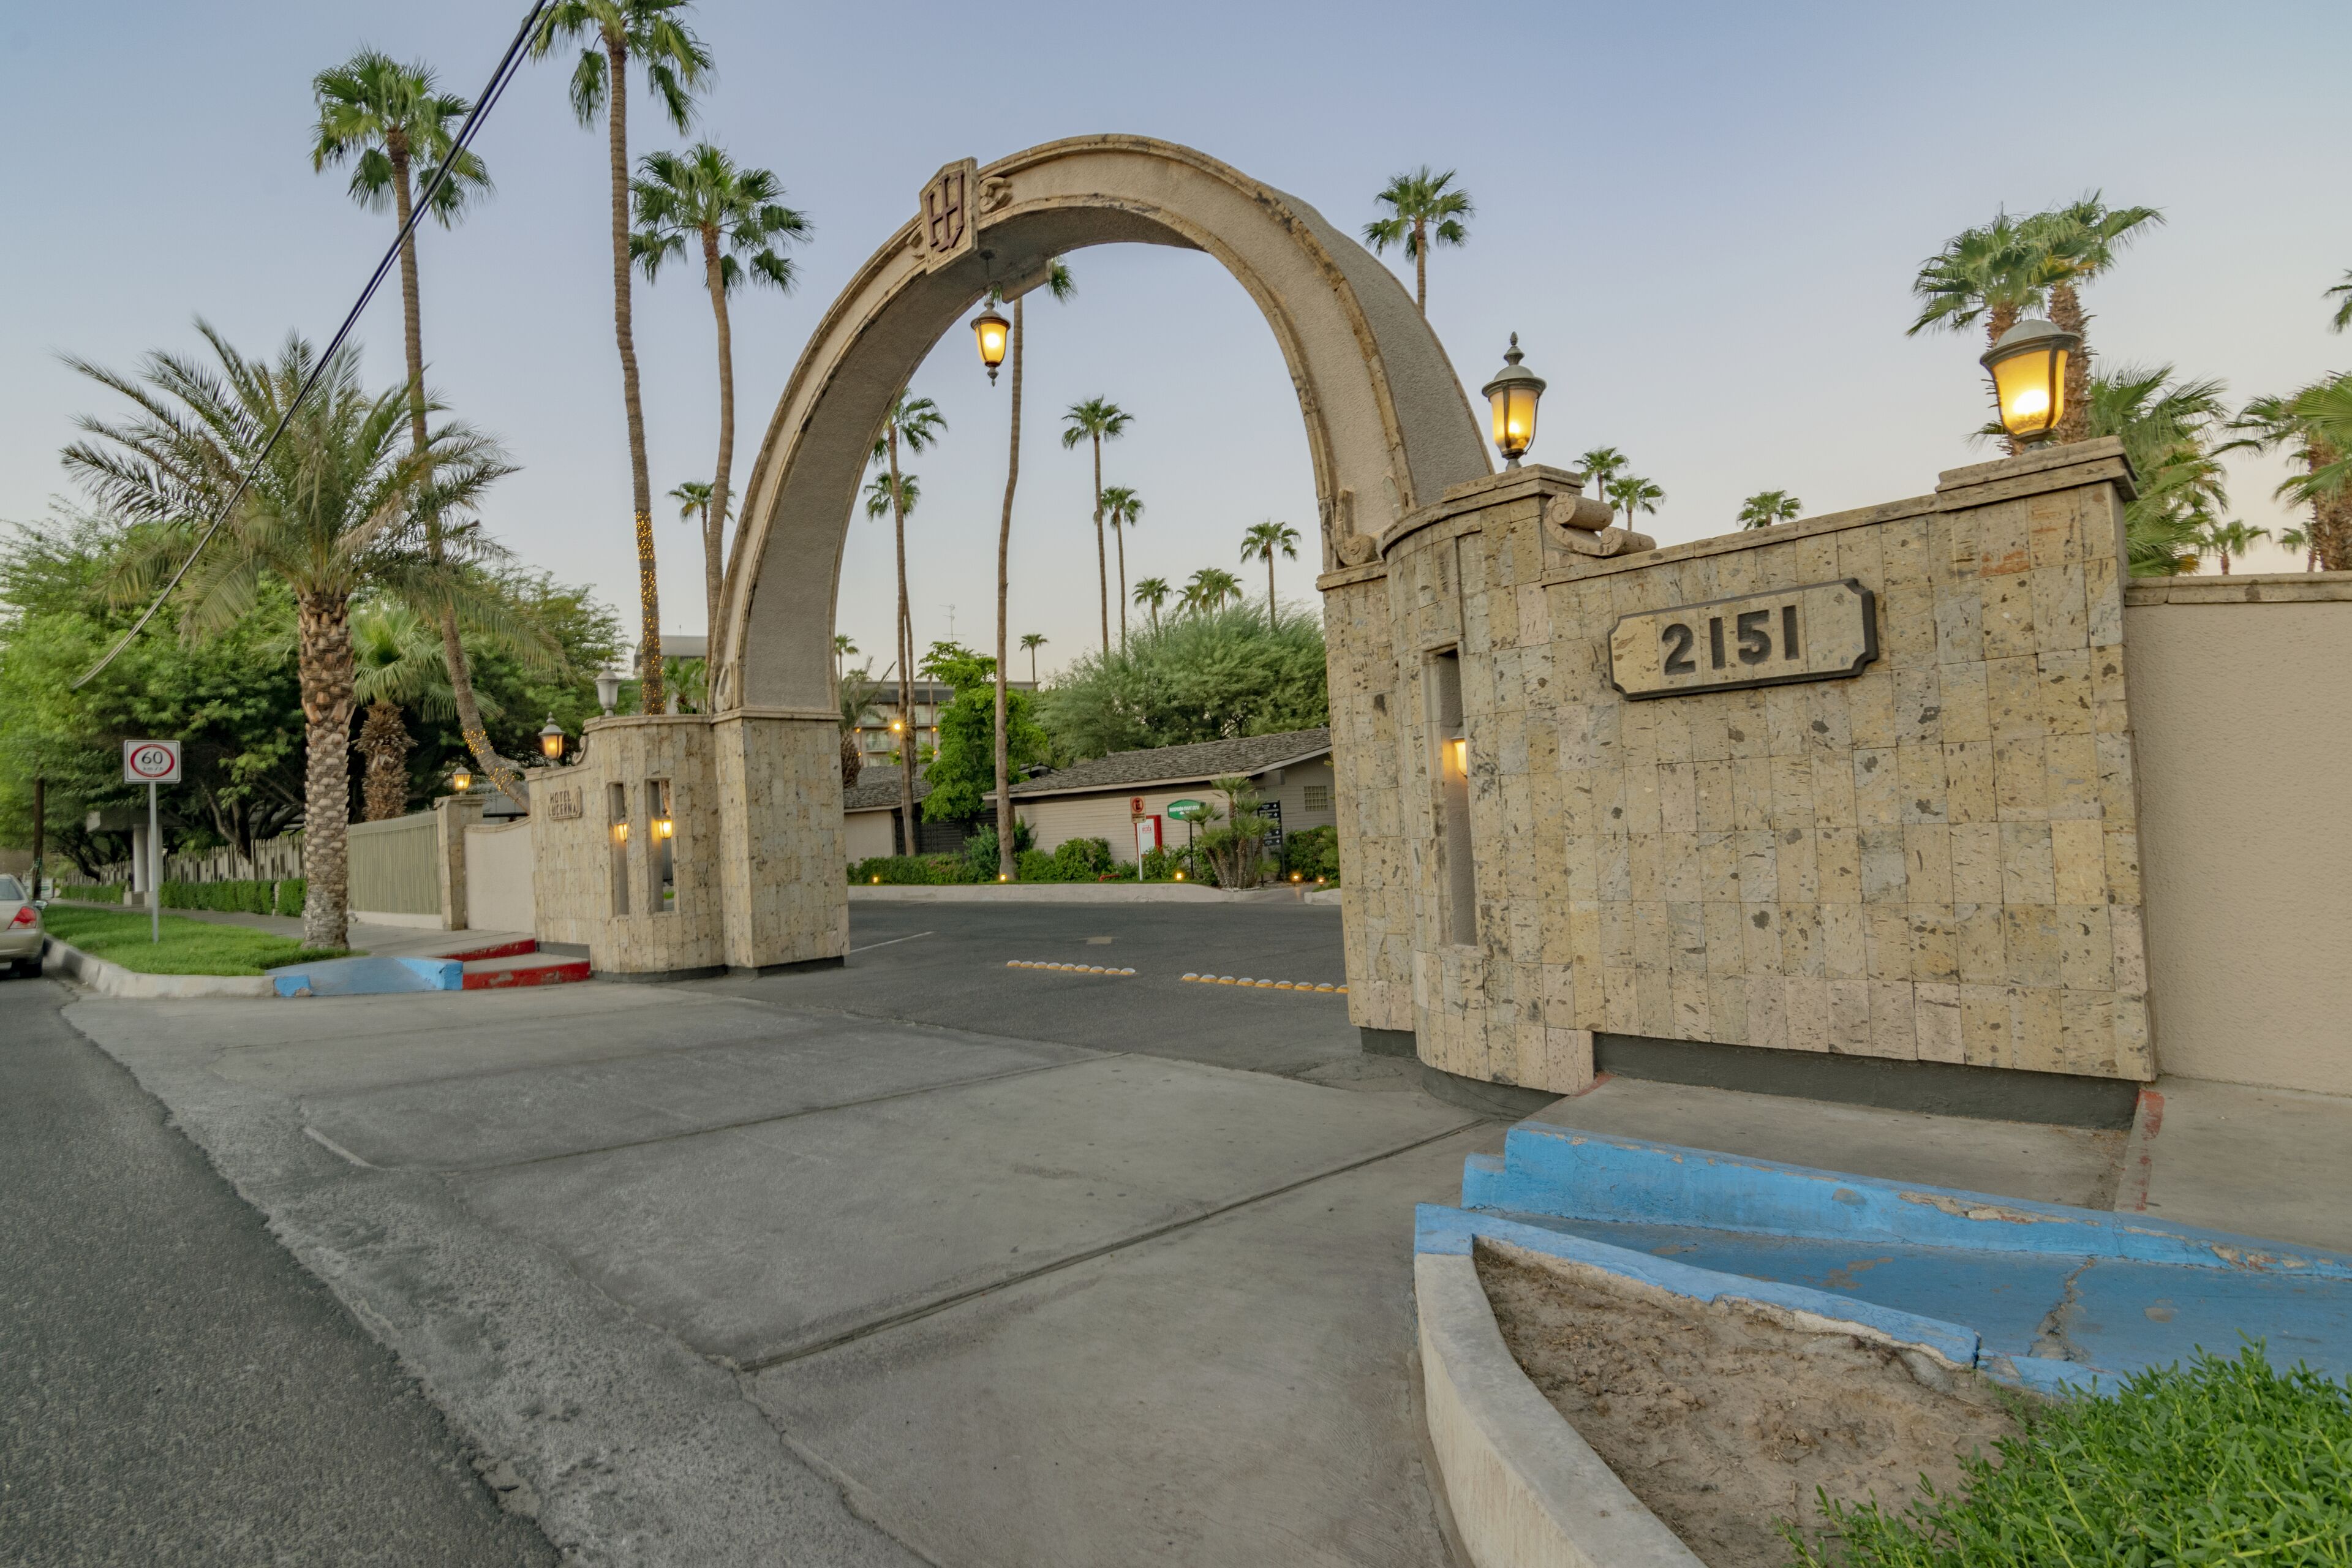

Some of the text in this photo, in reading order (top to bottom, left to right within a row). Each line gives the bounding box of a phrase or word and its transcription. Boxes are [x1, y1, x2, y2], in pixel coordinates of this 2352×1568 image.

[1662, 605, 1800, 675] 2151
[141, 751, 163, 764] 60
[550, 790, 571, 804] HOTEL
[548, 803, 578, 816] LUCERNA
